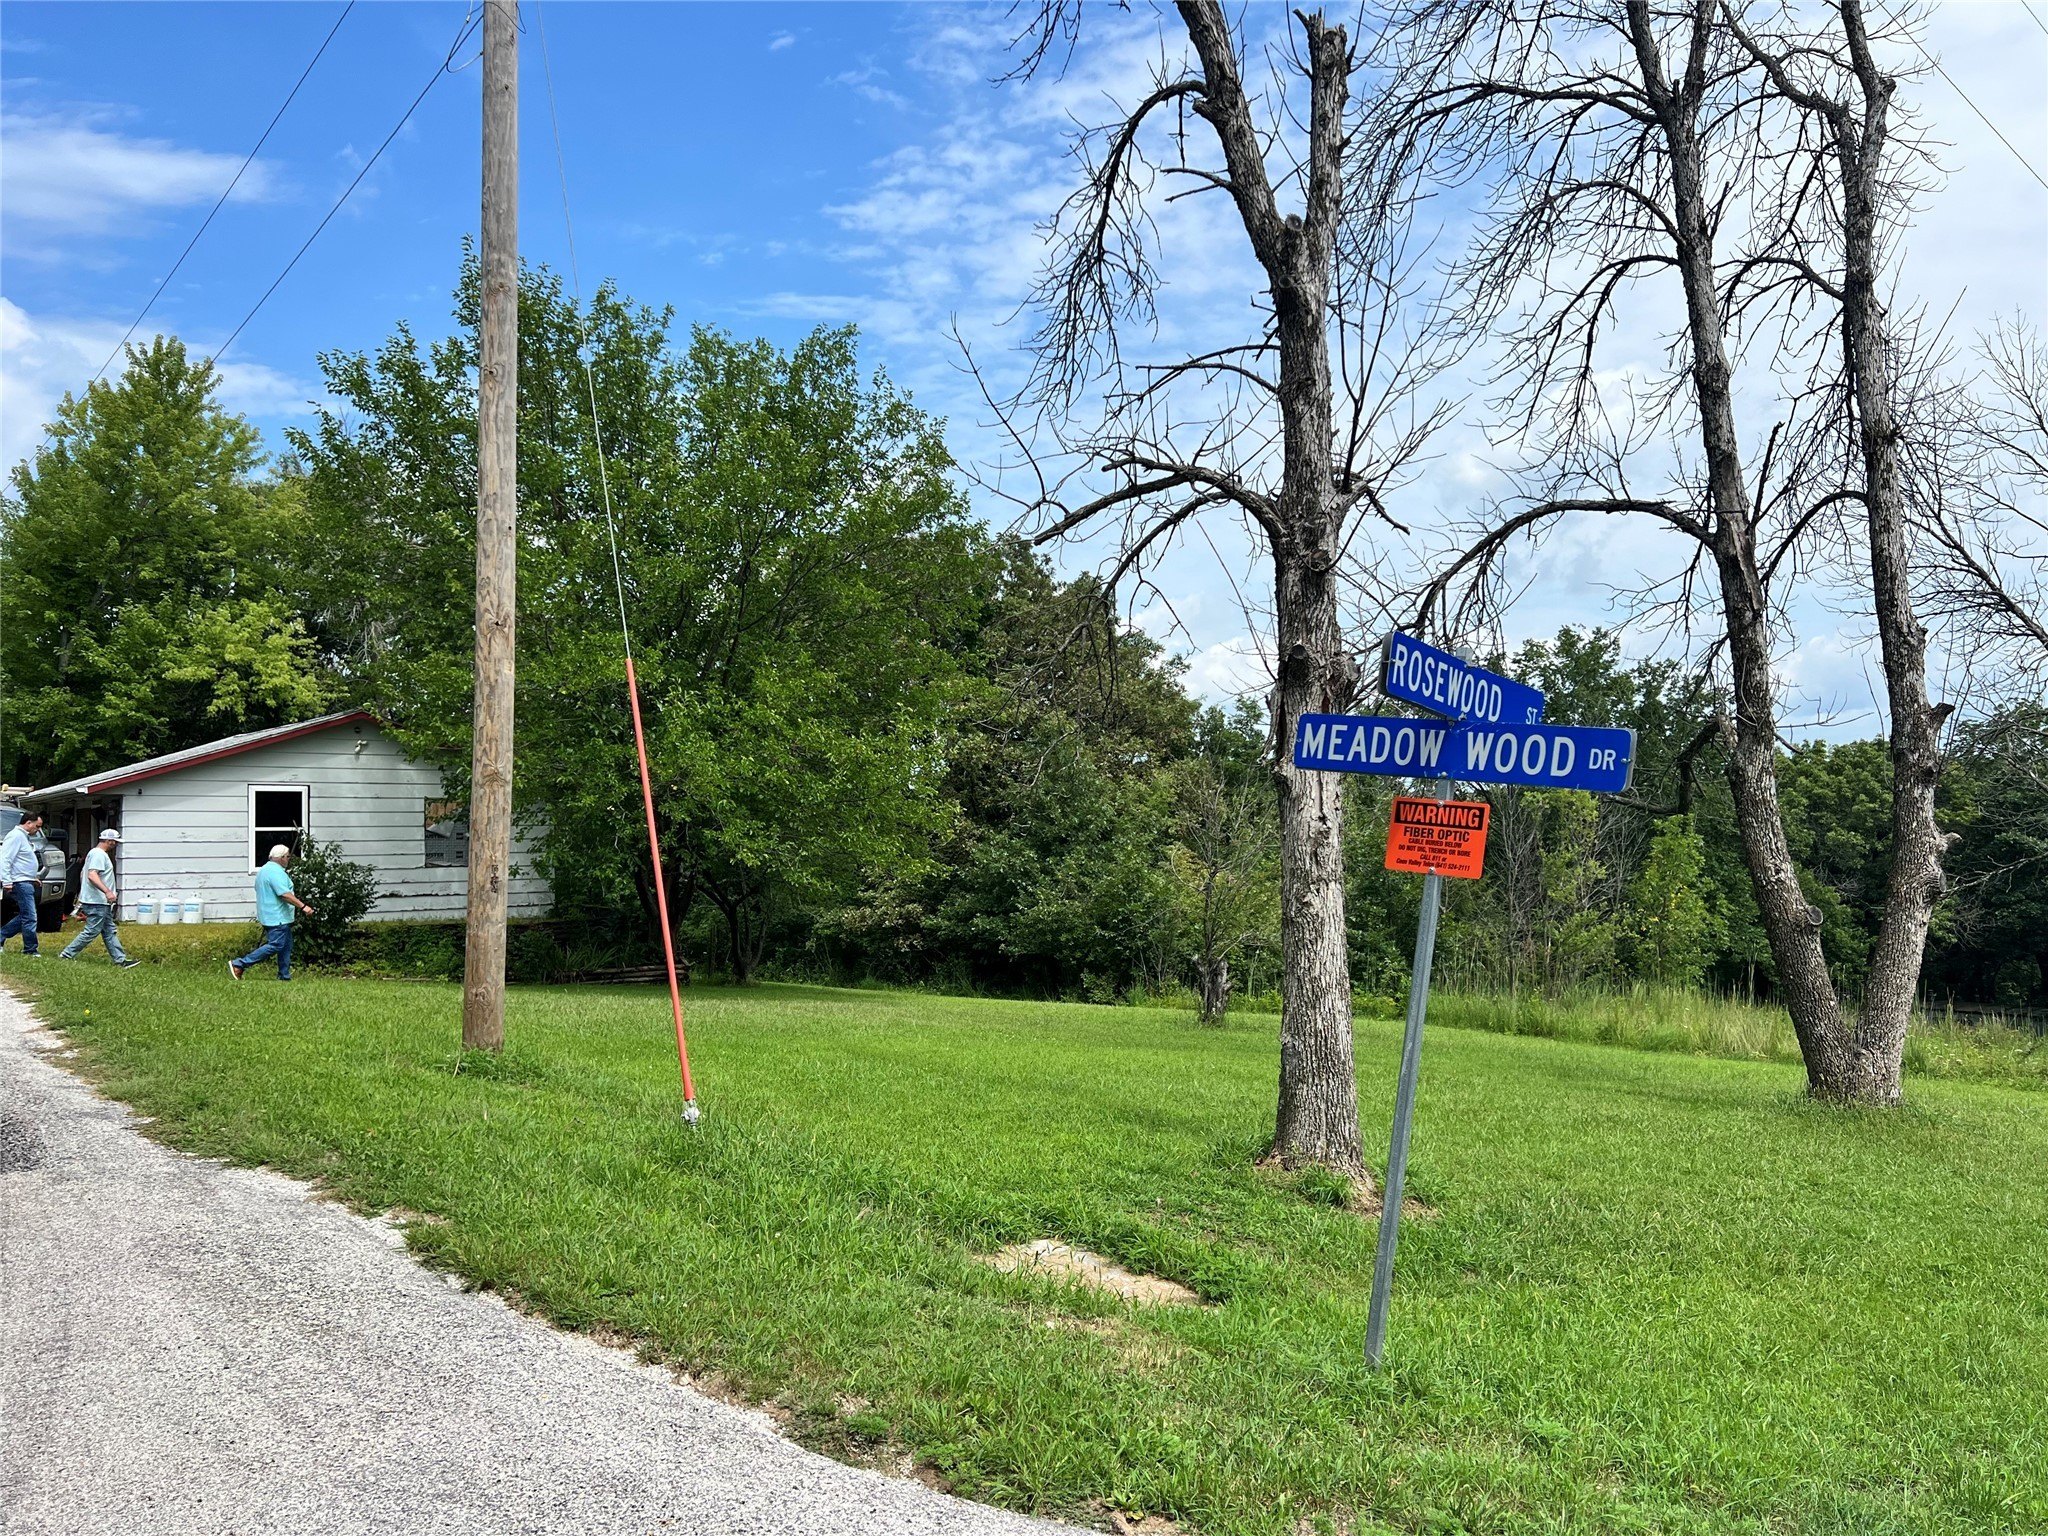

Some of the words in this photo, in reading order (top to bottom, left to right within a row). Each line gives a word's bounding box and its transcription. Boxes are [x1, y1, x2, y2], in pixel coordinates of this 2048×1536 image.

[1392, 643, 1502, 723] ROSEWOOD
[1525, 706, 1538, 725] ST
[1301, 722, 1446, 768] MEADOW
[1467, 731, 1576, 777] WOOD
[1589, 748, 1617, 771] DR
[1400, 803, 1480, 827] WARNING
[1403, 826, 1434, 839] FIBER
[1437, 830, 1470, 842] OPTIC
[1416, 846, 1427, 854] DIG,
[1425, 840, 1443, 848] BURIED
[1408, 859, 1422, 867] Valley
[1420, 854, 1431, 862] CALL
